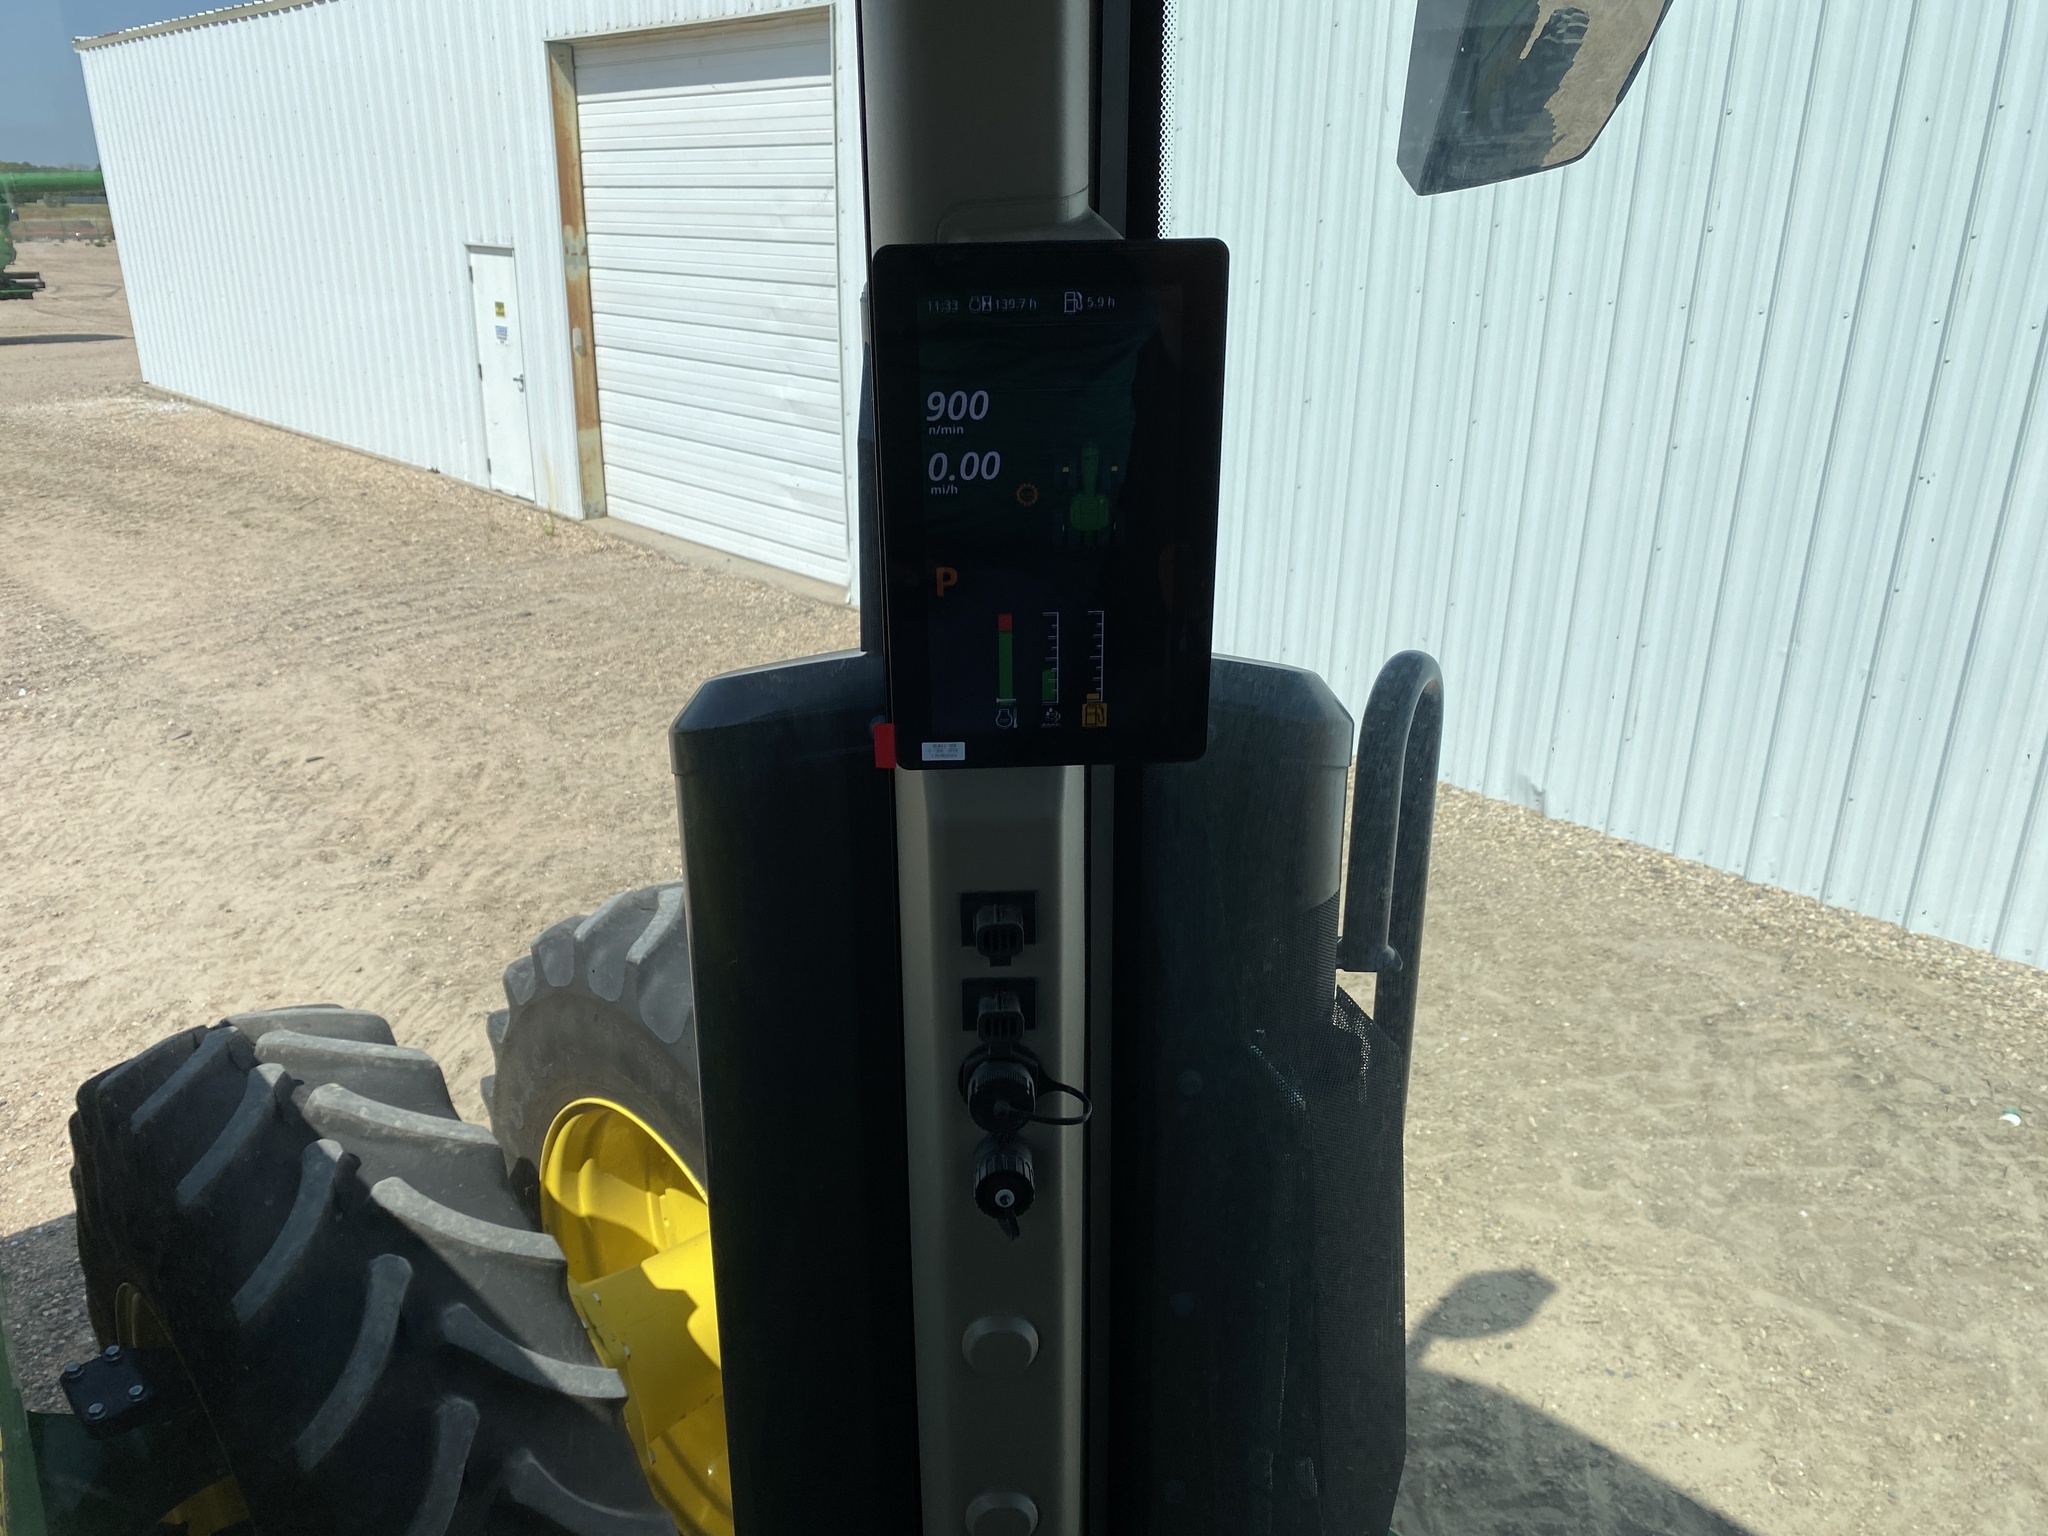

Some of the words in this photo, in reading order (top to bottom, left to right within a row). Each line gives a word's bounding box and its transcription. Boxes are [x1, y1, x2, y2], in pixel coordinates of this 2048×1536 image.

[1029, 297, 1037, 311] h
[926, 390, 990, 422] 900
[928, 424, 964, 435] n/min
[928, 451, 1001, 482] 0.00
[930, 484, 958, 495] mi/h
[935, 566, 958, 597] P
